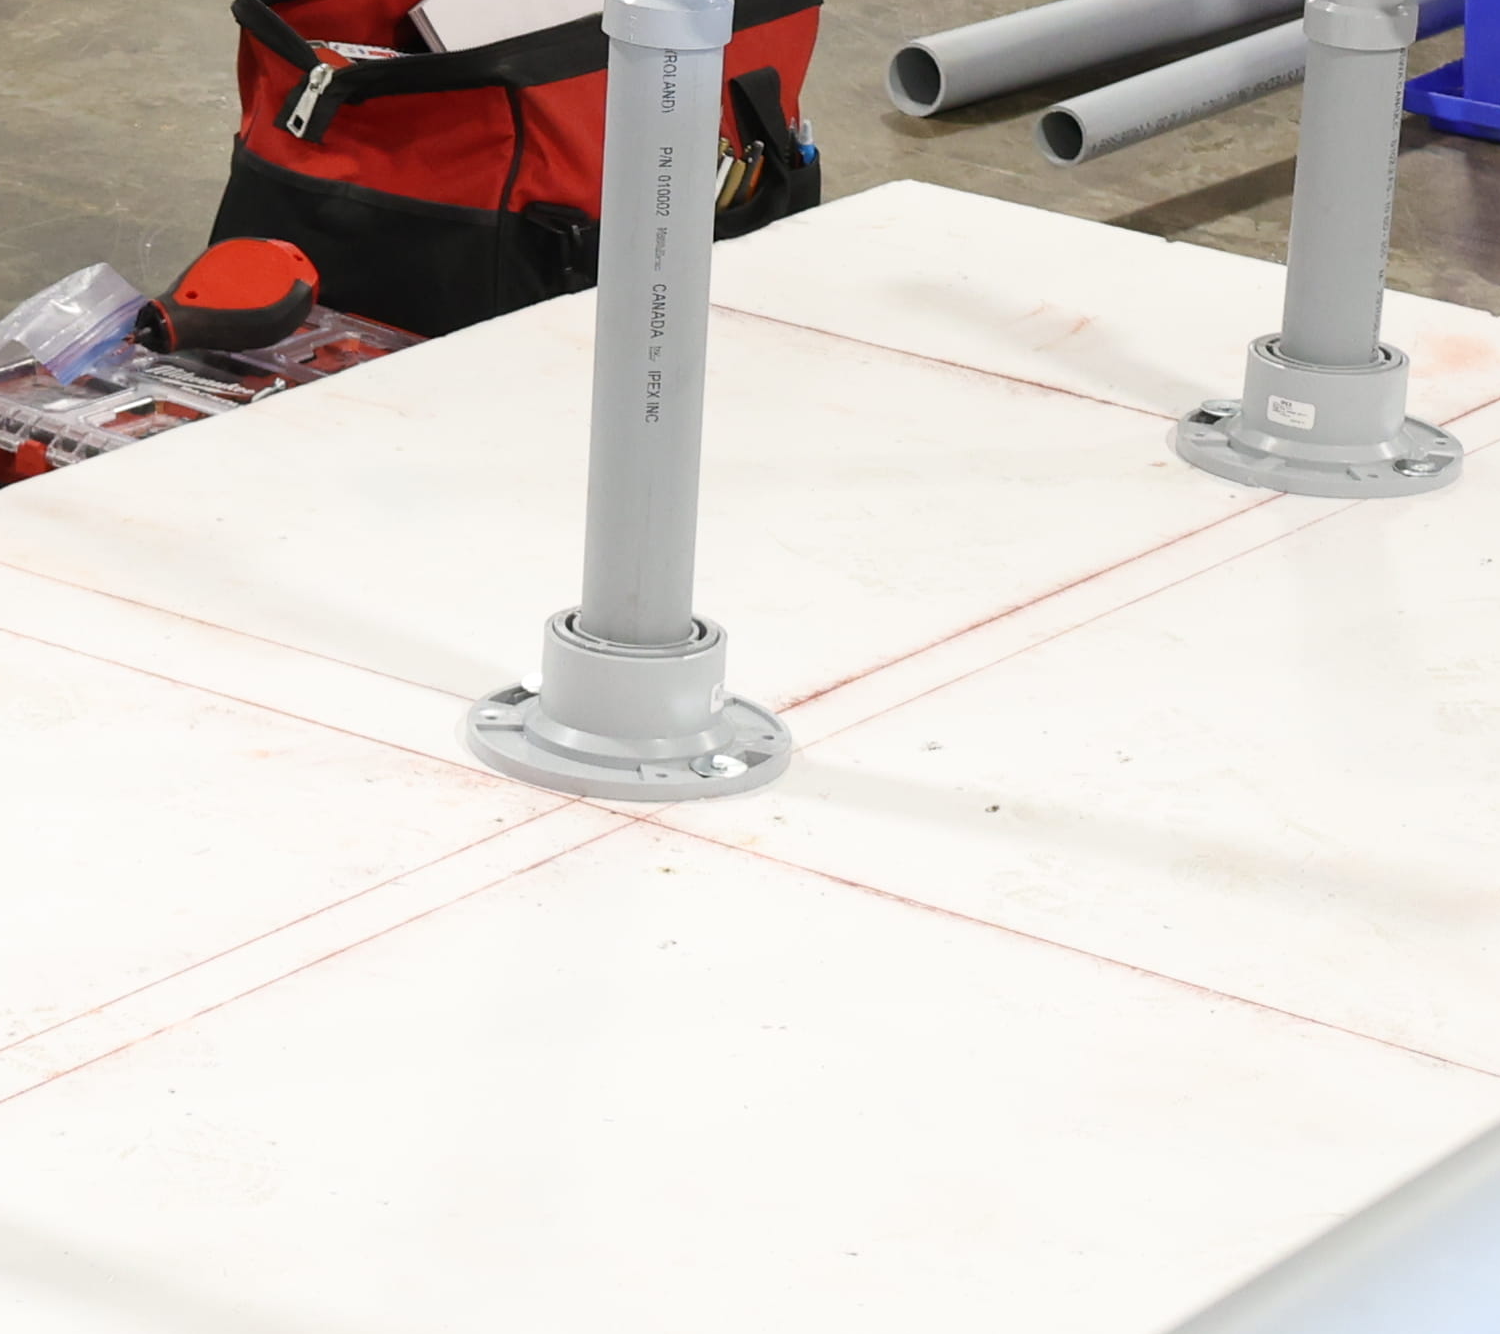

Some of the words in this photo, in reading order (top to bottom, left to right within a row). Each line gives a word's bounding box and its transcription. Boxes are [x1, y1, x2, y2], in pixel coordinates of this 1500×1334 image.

[658, 146, 674, 168] P/N
[655, 175, 672, 217] 010002
[650, 283, 667, 339] CANADA
[648, 370, 662, 399] IPEX
[644, 402, 660, 424] INC
